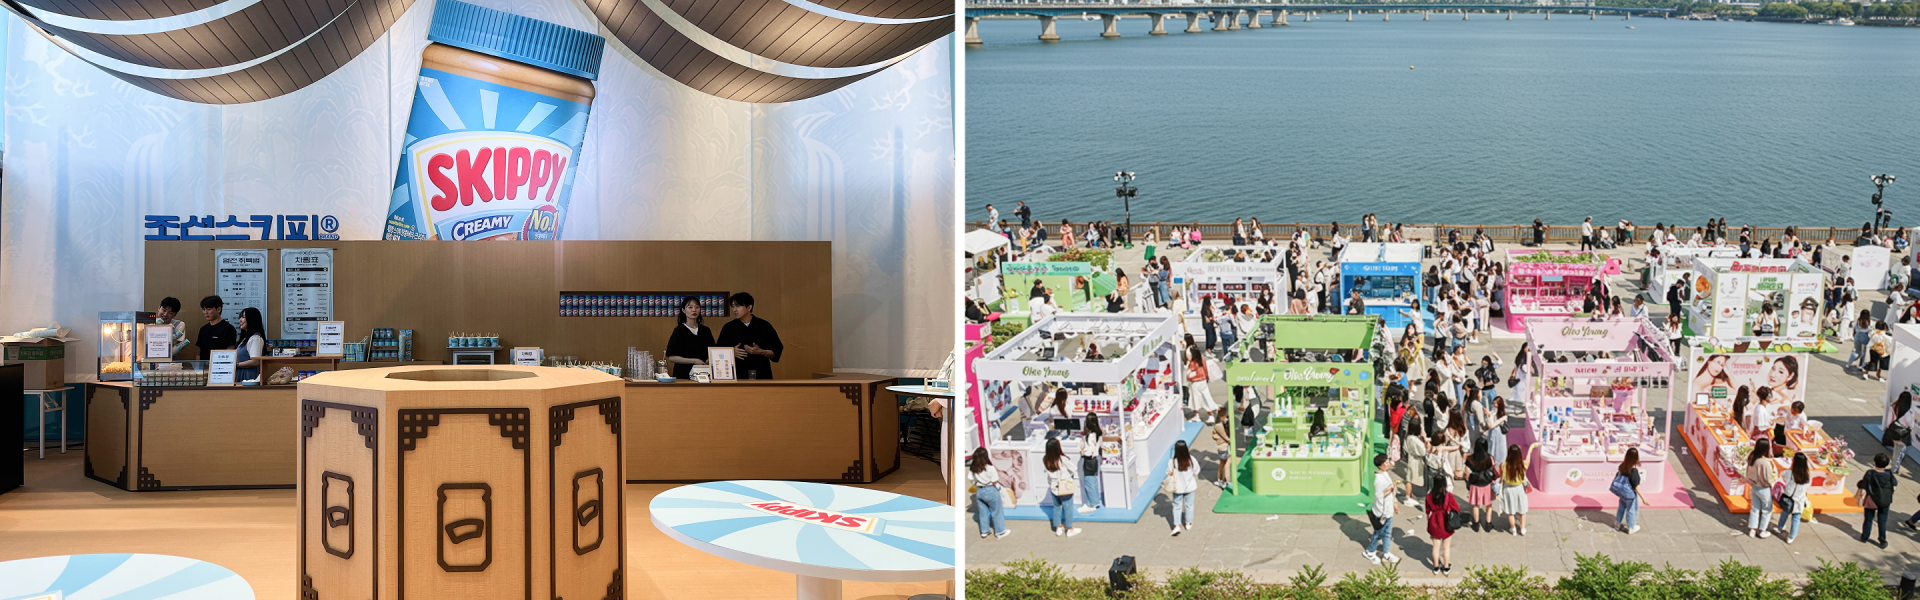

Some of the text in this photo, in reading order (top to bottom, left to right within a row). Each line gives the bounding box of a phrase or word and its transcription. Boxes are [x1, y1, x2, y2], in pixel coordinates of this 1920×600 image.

[427, 146, 567, 212] SKIPPY
[452, 214, 513, 240] CREAMY
[528, 209, 559, 232] No.1
[750, 502, 867, 527] SKIPPY
